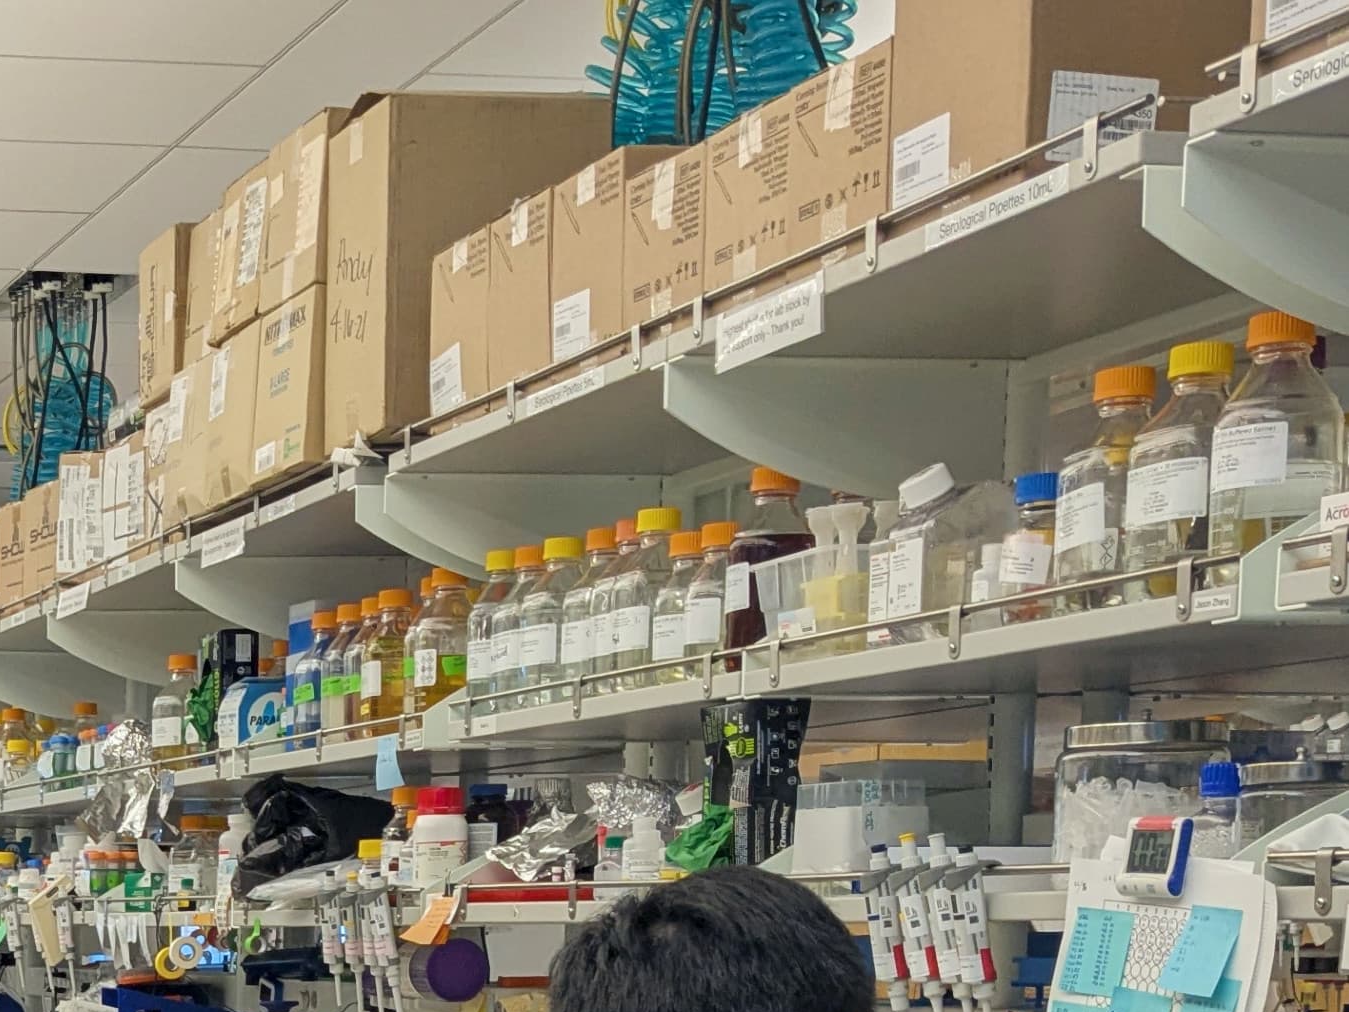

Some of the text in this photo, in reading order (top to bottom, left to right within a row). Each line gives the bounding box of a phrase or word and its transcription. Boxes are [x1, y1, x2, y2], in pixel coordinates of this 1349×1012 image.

[988, 192, 1026, 218] Pipettes
[1028, 180, 1053, 202] 10mL
[336, 237, 374, 296] Andy
[771, 319, 790, 336] Thank
[250, 715, 277, 727] PARA
